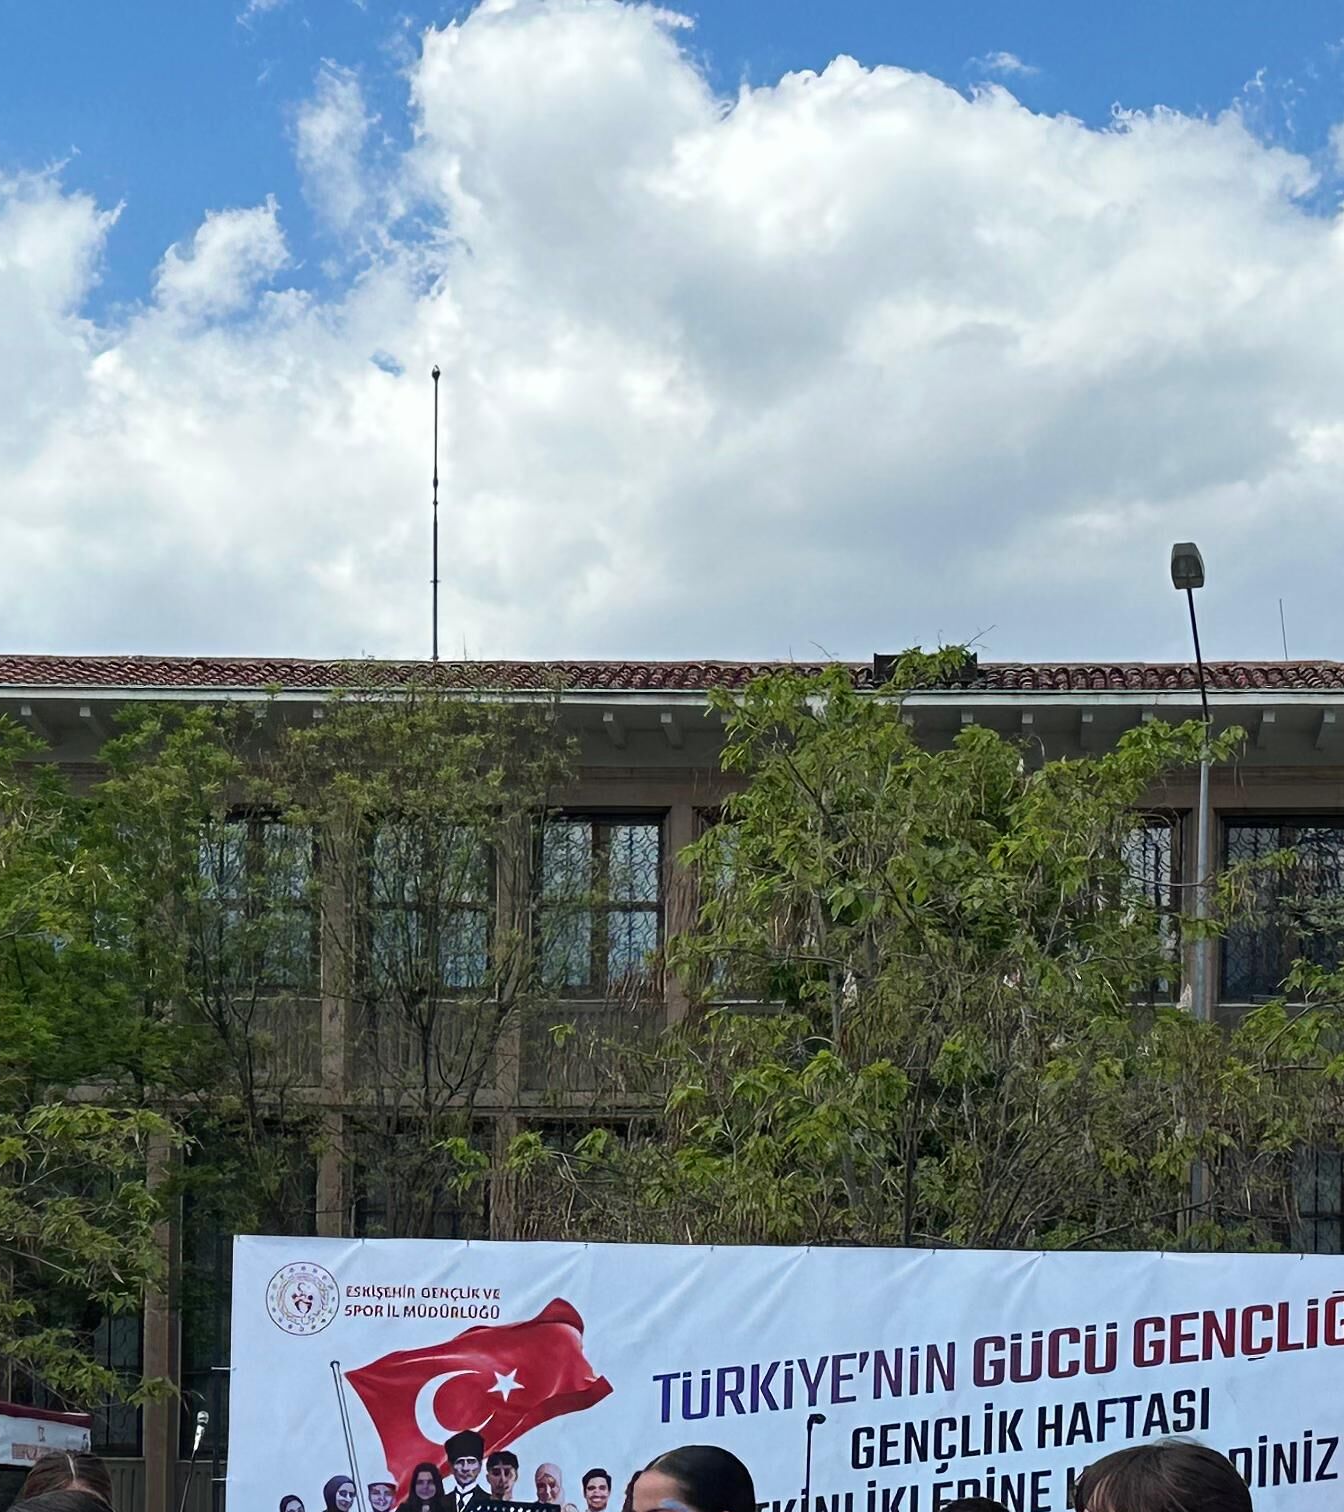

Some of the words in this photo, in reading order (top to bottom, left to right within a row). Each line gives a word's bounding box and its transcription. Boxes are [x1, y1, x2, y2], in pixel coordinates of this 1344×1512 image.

[344, 1304, 384, 1318] SPOR
[387, 1303, 400, 1318] İL
[483, 1287, 501, 1300] VE
[652, 1341, 957, 1424] TÜRKİYE'NİN
[972, 1322, 1119, 1388] GÜCÜ
[850, 1402, 1026, 1474] GENÇLİK
[1036, 1386, 1211, 1448] HAFTASI
